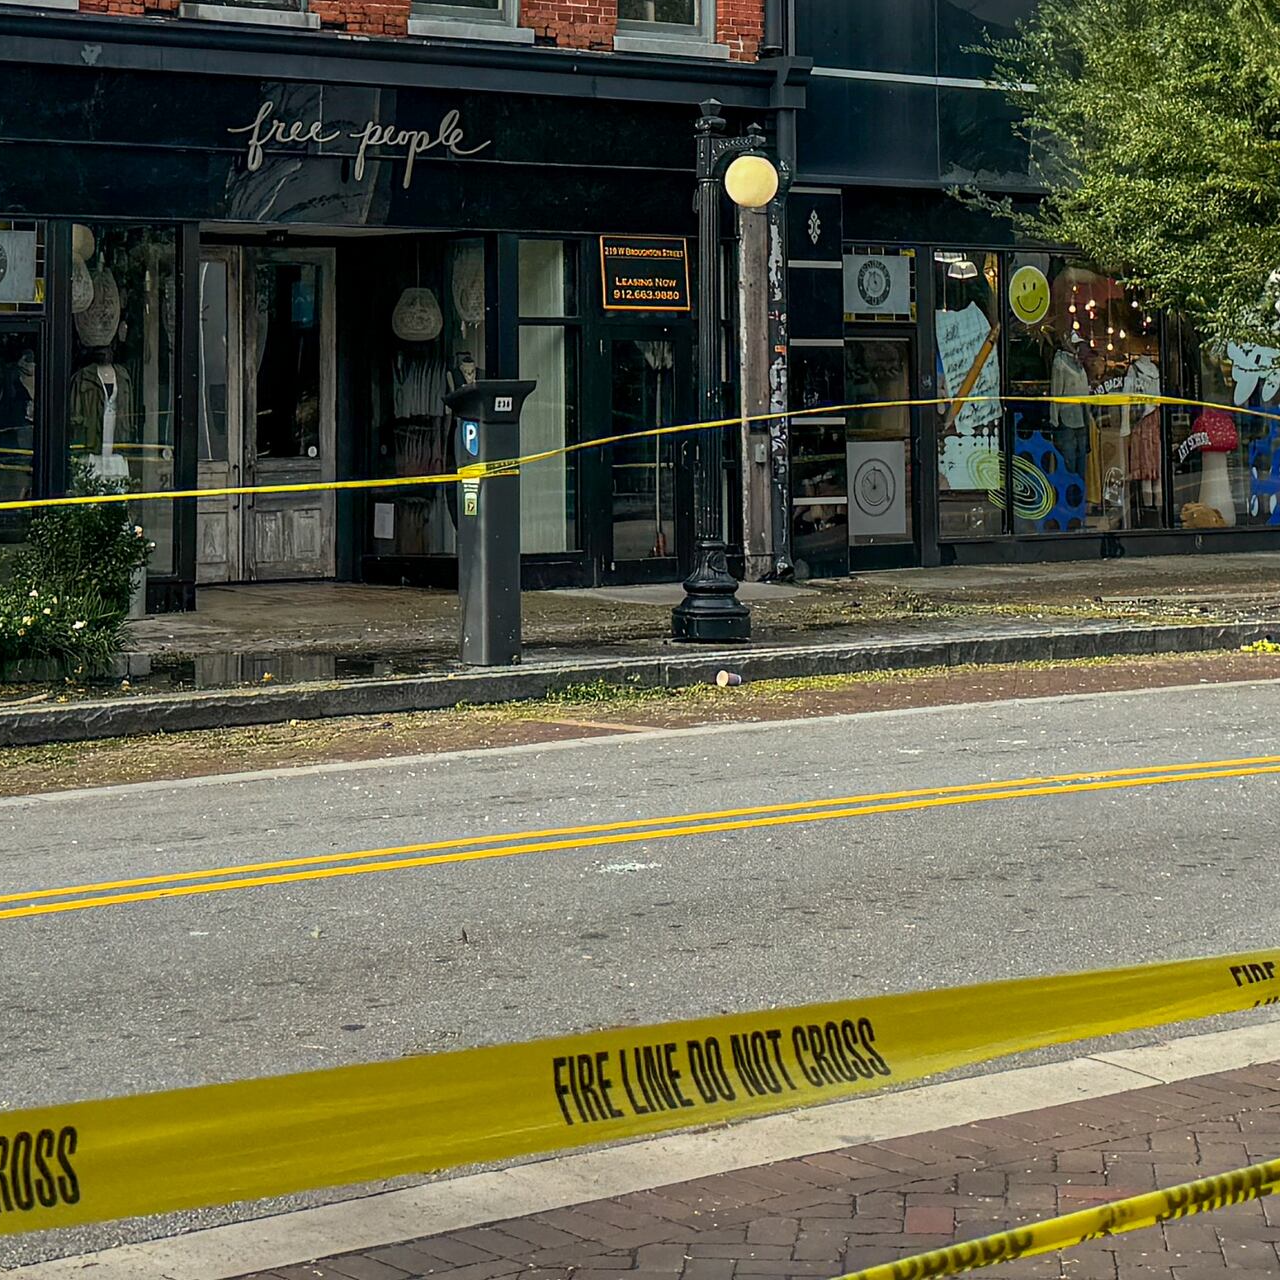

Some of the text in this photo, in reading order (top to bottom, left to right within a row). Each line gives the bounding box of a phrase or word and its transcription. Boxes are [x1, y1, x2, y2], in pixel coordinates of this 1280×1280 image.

[227, 101, 491, 189] free people
[604, 246, 618, 256] 219
[618, 247, 626, 255] W
[552, 1017, 892, 1126] FIRE LINE DO NOT CROSS
